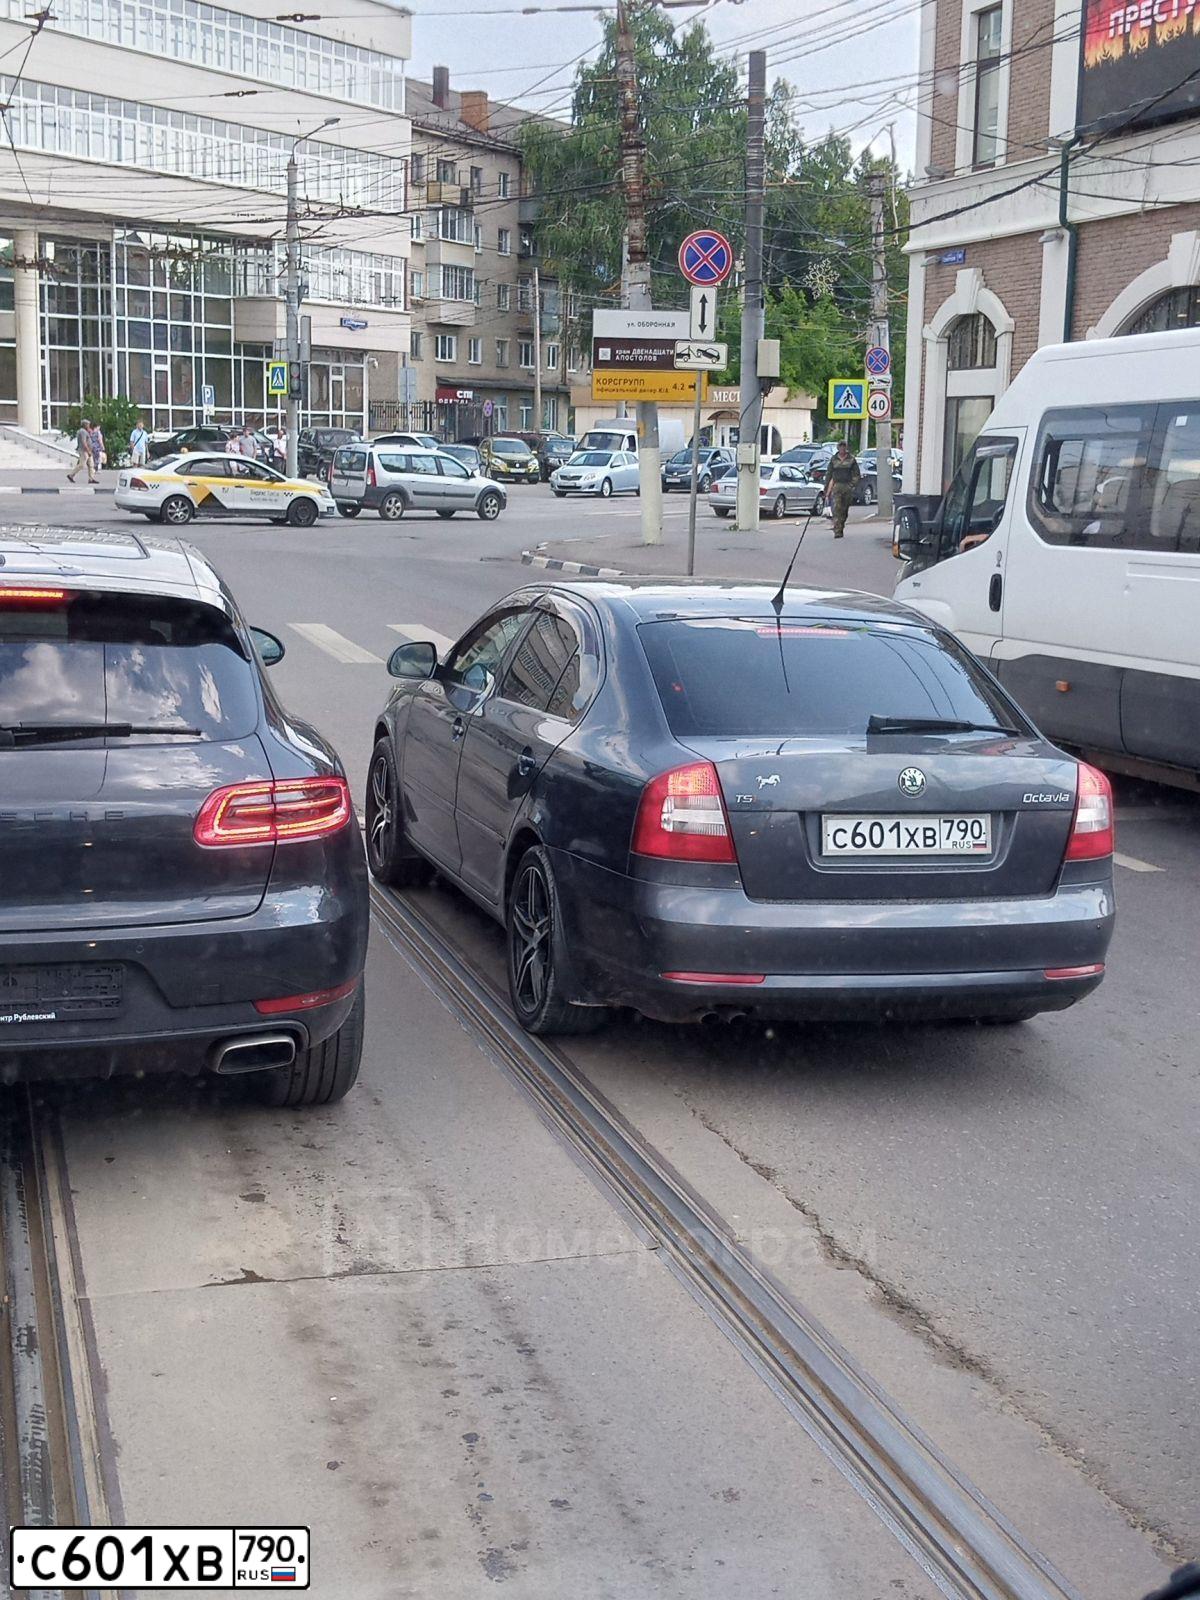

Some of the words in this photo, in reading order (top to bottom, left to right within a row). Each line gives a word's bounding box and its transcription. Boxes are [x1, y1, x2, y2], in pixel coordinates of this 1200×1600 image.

[596, 377, 645, 386] КОРСГРУПП
[871, 400, 885, 411] 40
[1022, 793, 1069, 803] Octavia
[943, 820, 983, 840] 790
[0, 1015, 13, 1023] нтр
